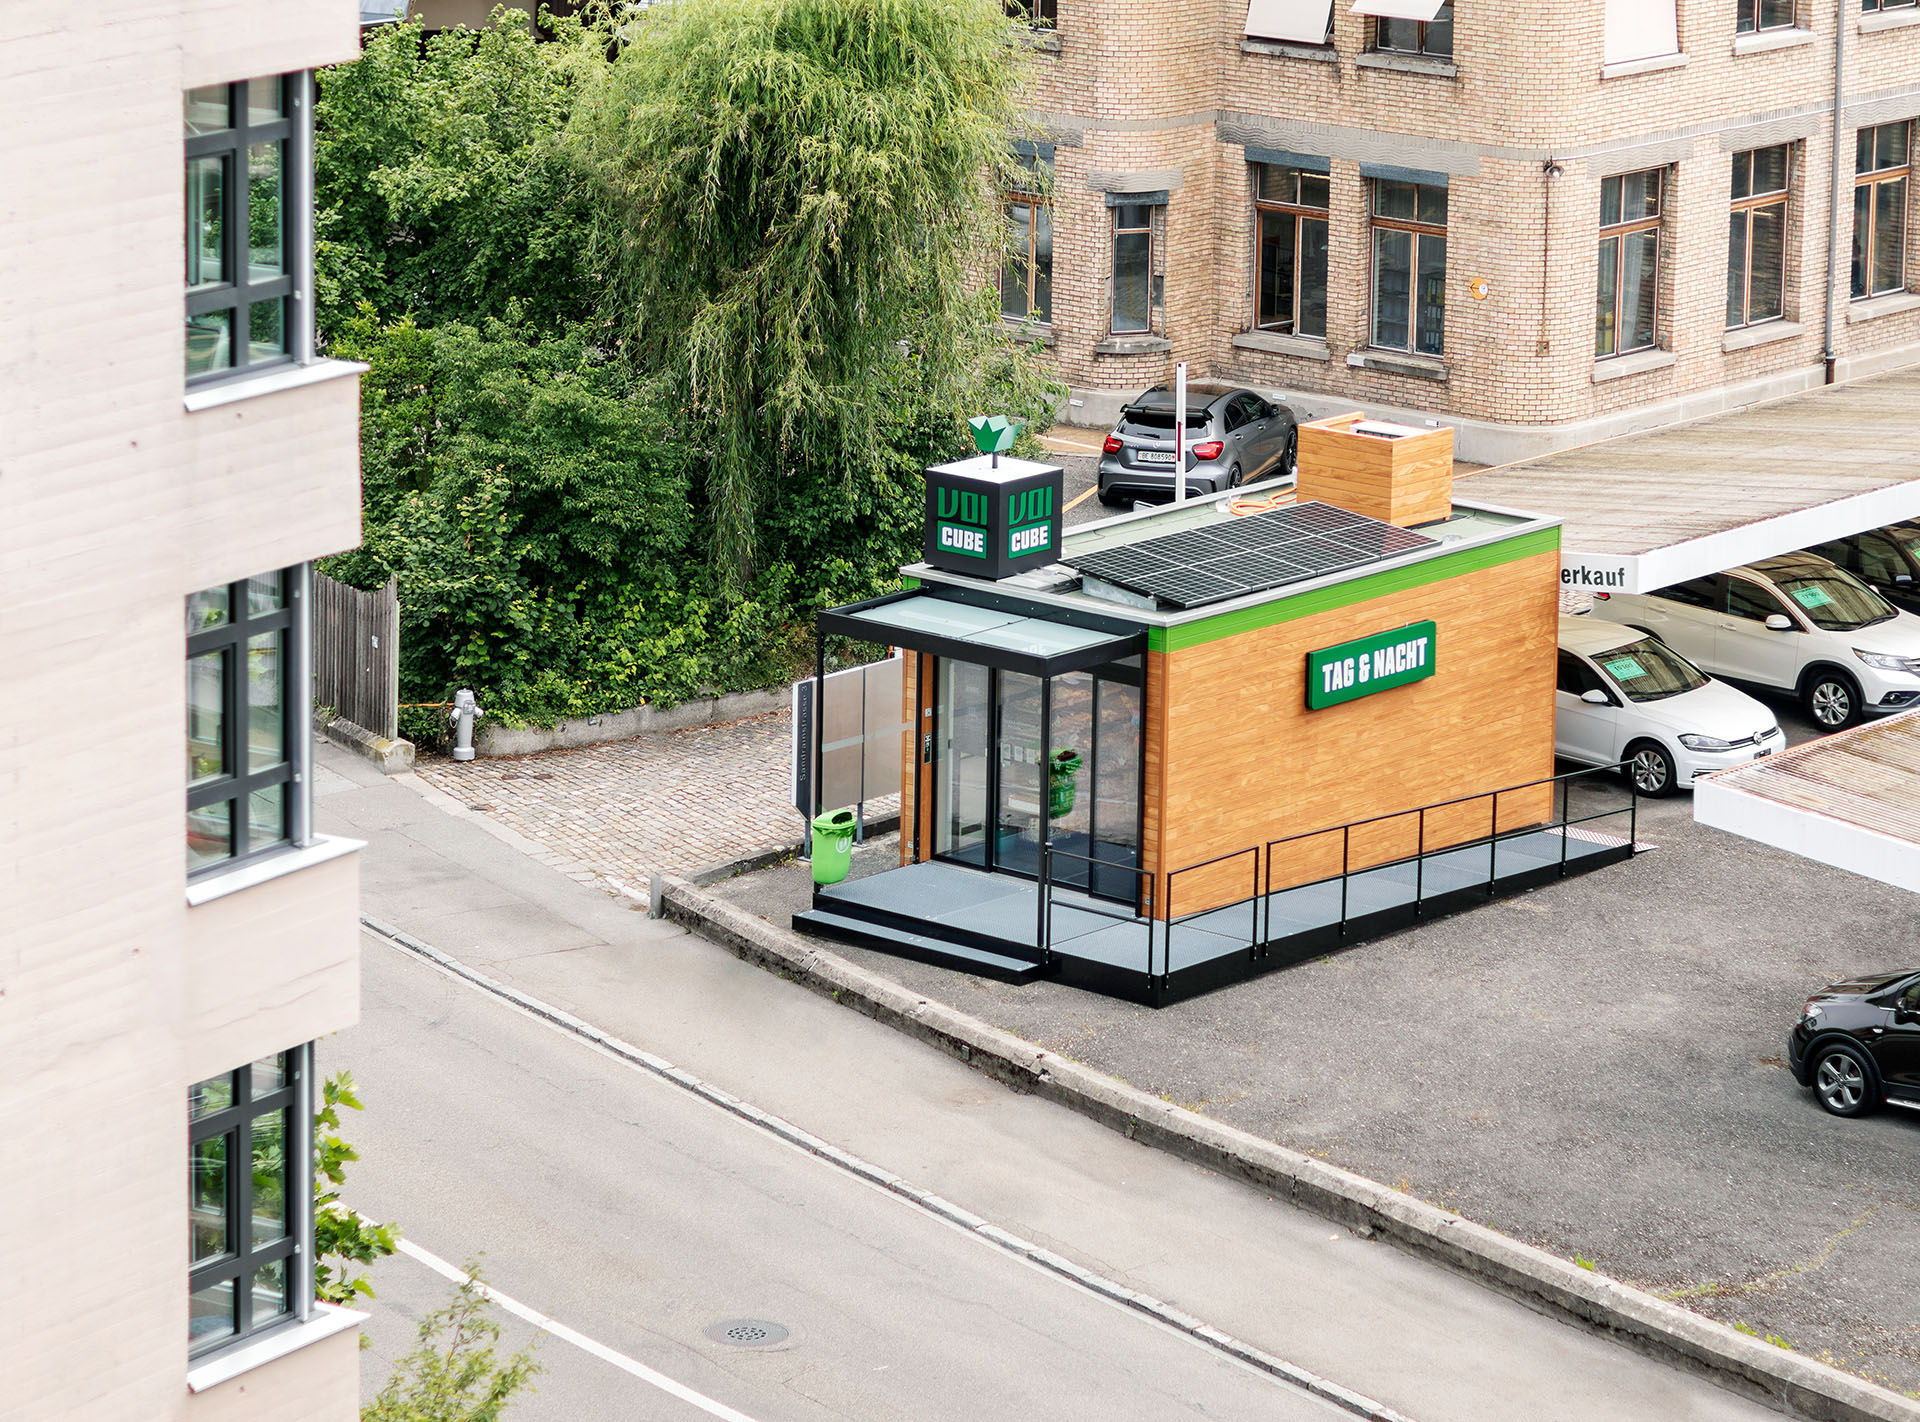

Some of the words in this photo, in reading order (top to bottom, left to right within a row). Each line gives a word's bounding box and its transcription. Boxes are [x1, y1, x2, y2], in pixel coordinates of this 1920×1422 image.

[938, 486, 988, 526] VOI
[1008, 486, 1053, 526] VOI
[941, 526, 984, 553] CUBE
[1011, 525, 1049, 552] CUBE
[1322, 657, 1355, 693] TAG
[1358, 653, 1371, 683] &
[1373, 637, 1428, 680] NACHT
